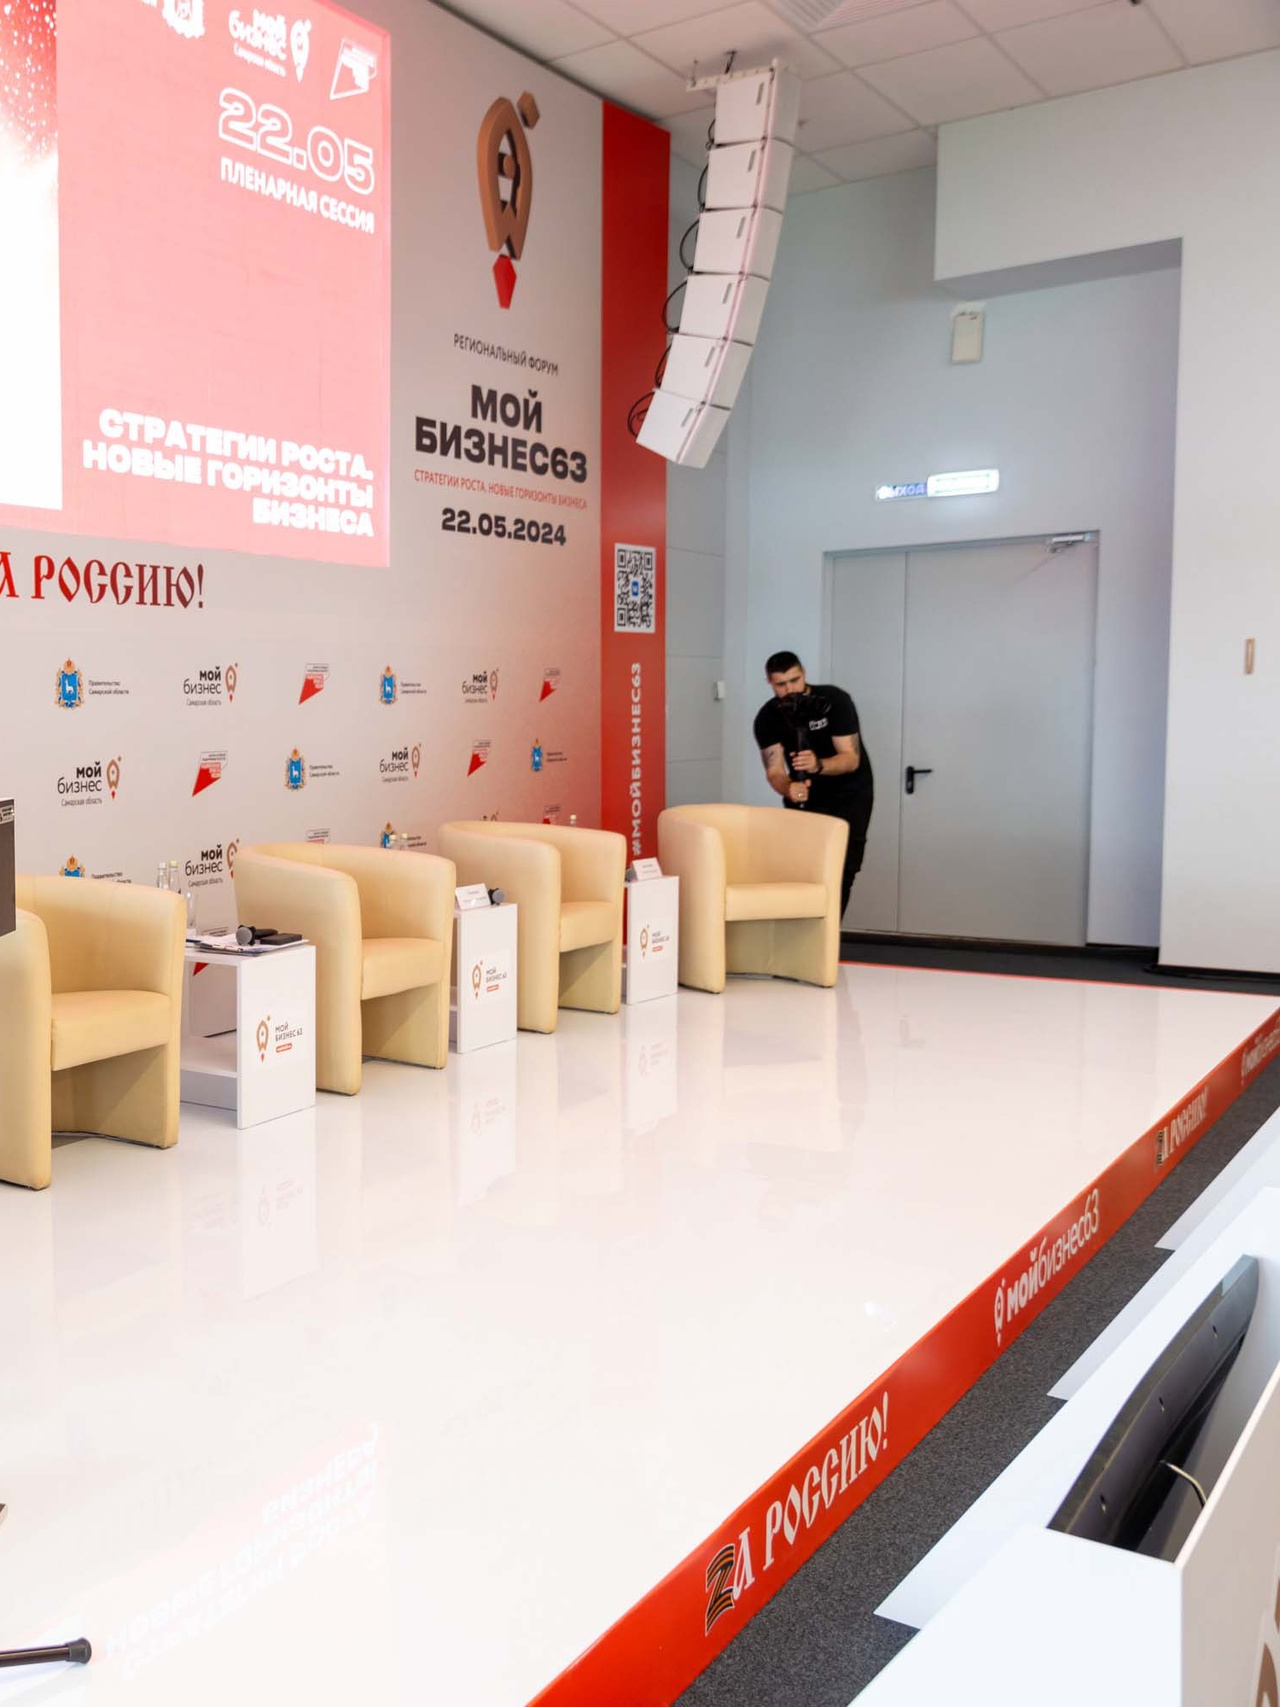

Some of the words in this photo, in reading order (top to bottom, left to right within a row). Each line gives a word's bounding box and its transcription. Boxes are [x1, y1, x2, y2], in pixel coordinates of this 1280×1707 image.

[218, 87, 375, 195] 22.05
[221, 157, 317, 213] ПЛЕНАРНАЯ
[319, 194, 375, 234] СЕССИЯ
[454, 333, 526, 367] РЕГИОНАЛЬНЫЙ
[528, 356, 558, 376] ФОРУМ
[471, 384, 543, 434] МОЙ
[99, 408, 277, 465] СТРАТЕГИИ
[281, 441, 374, 480] РОСТА.
[415, 416, 588, 484] БИЗНЕС63
[82, 440, 202, 485] НОВЫЕ
[208, 459, 374, 509] ГОРИЗОНТЫ
[414, 469, 459, 487] СТРАТЕГИИ
[252, 497, 374, 537] БИЗНЕСА
[441, 507, 566, 546] 22.05.2024
[31, 554, 204, 609] РОССИЮ!
[183, 678, 221, 694] бизнес
[200, 666, 221, 681] мой
[76, 761, 101, 778] мой
[392, 747, 408, 760] мой
[630, 662, 642, 855] #МОЙБИЗНЕС63
[58, 777, 102, 794] бизнес
[185, 860, 223, 876] бизнес
[201, 844, 222, 861] мой
[1007, 1188, 1100, 1323] мойбизнес63
[763, 1391, 889, 1571] РОССИЮ!
